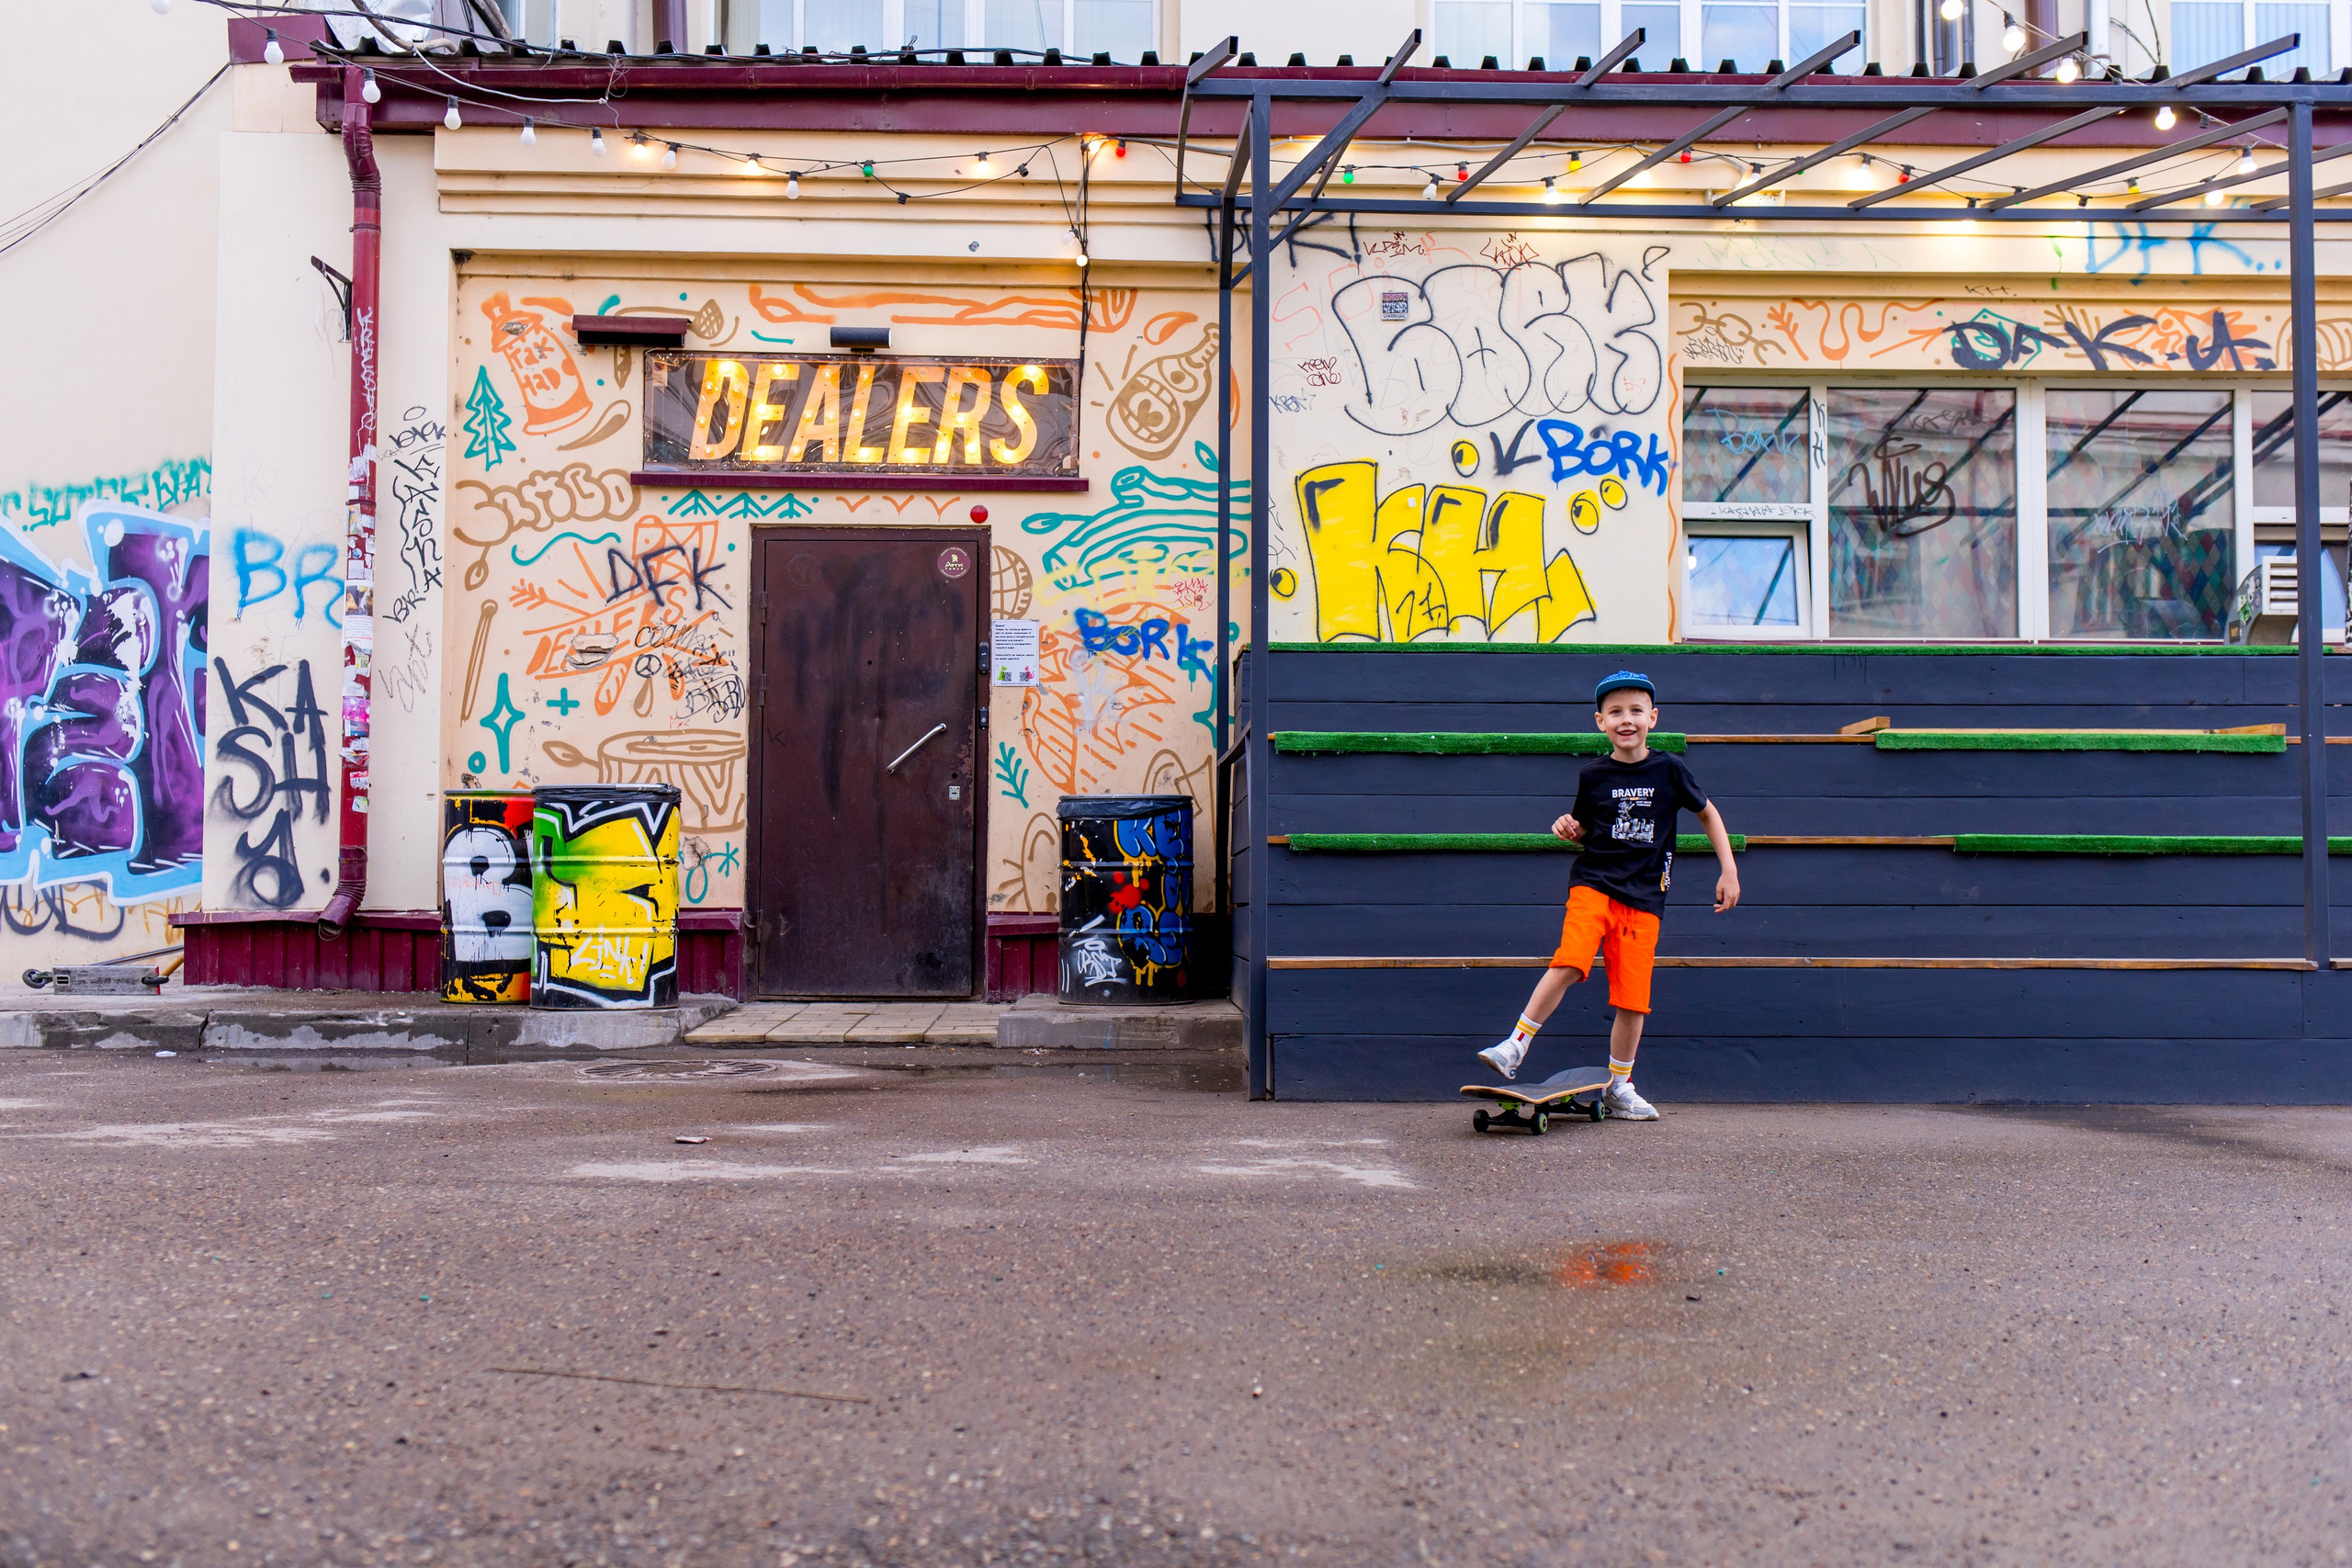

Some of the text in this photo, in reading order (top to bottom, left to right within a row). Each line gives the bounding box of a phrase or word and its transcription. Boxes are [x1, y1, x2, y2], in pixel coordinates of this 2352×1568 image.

[689, 359, 1049, 464] DEALERS
[1537, 419, 1669, 497] BORK
[1074, 607, 1215, 682] BORK
[1611, 788, 1655, 798] BRAVERY
